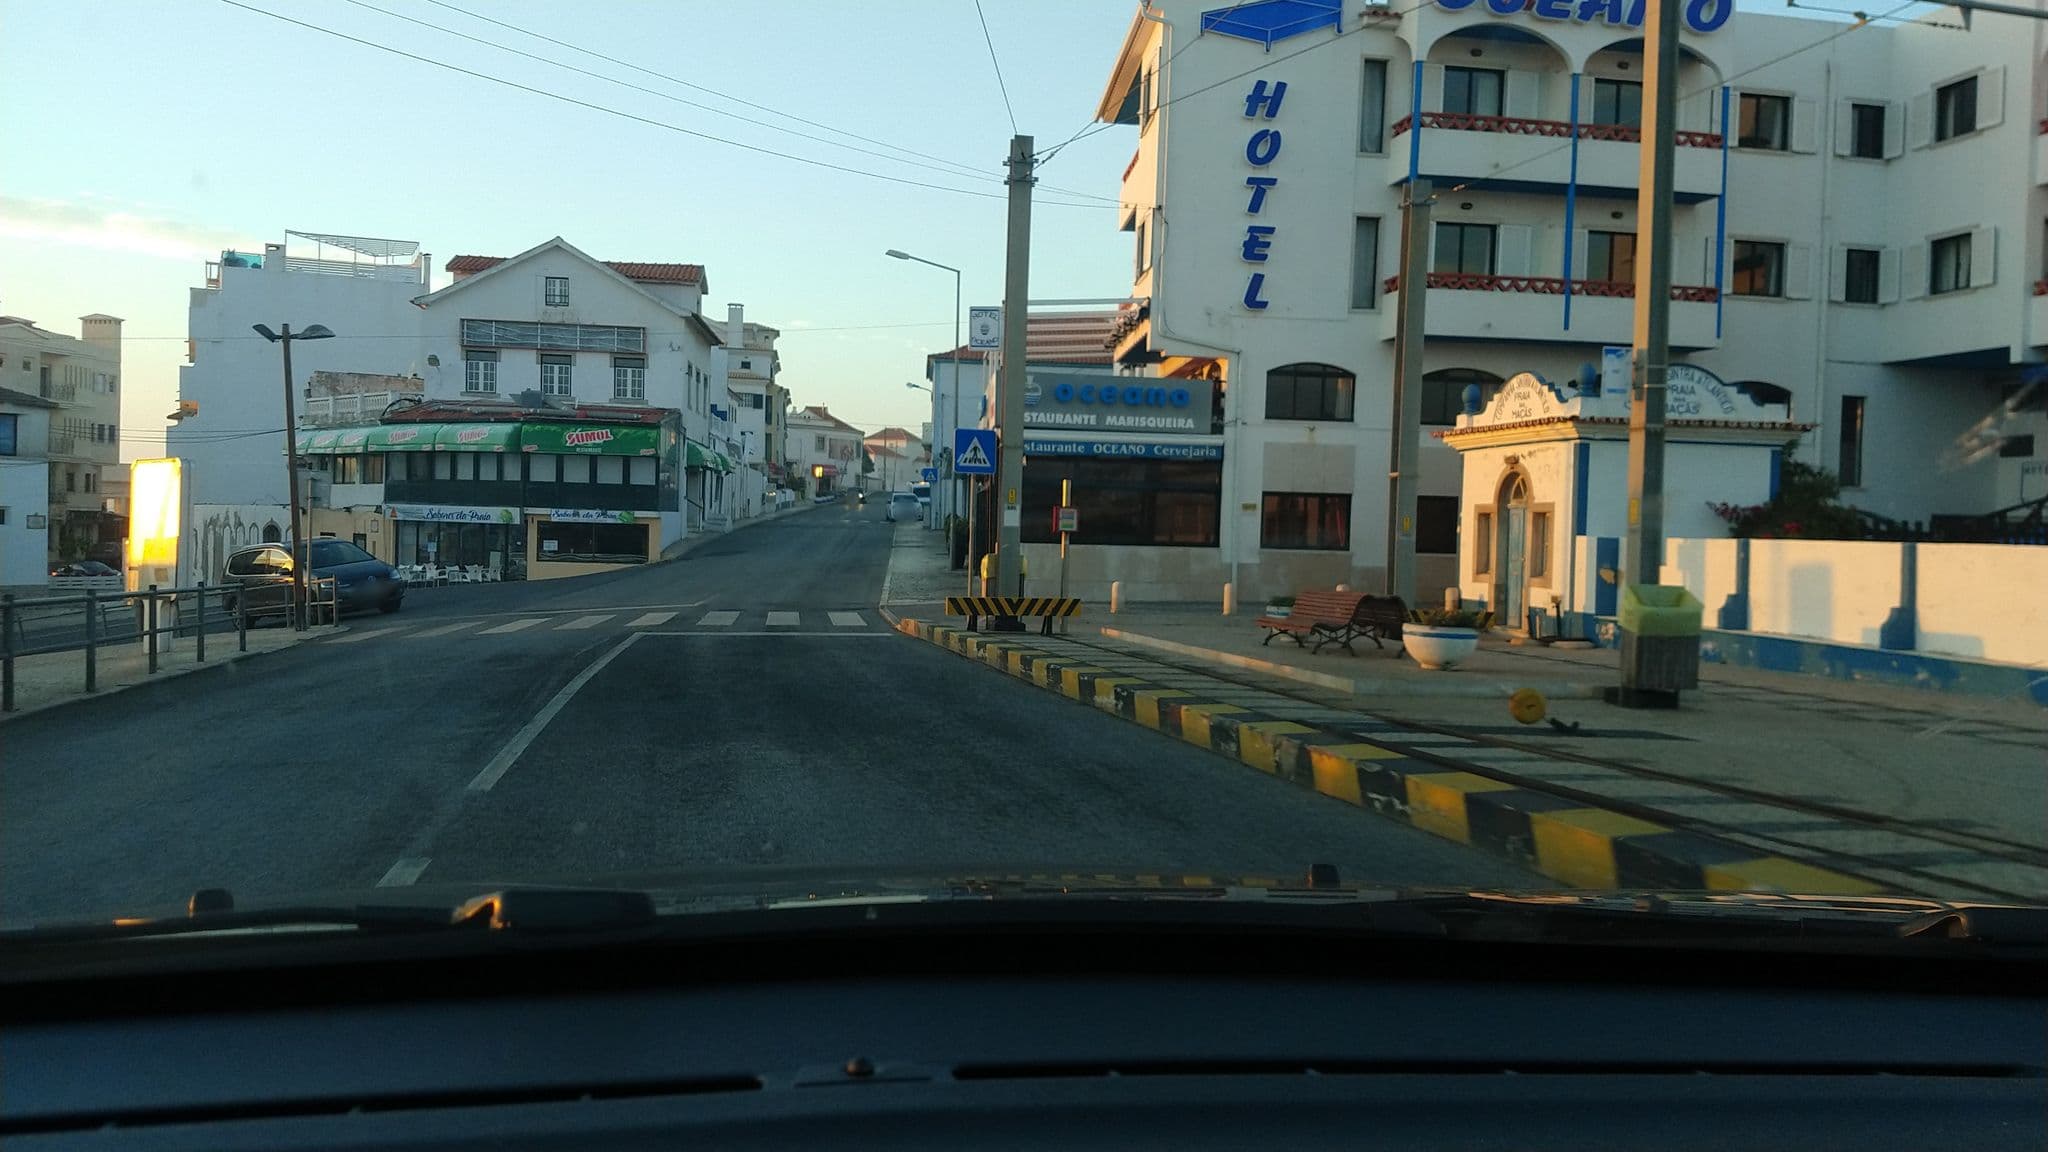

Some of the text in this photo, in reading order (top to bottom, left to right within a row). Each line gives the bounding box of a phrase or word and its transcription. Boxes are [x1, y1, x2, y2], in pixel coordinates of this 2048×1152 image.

[1436, 0, 1733, 33] EAO
[1244, 78, 1289, 311] HOTEL
[1055, 382, 1191, 407] oceano
[1024, 412, 1195, 429] STAURANTE MARISQUEIRA
[566, 429, 613, 445] SUMOL
[1024, 441, 1217, 459] staurante OCEANO Cervejaria
